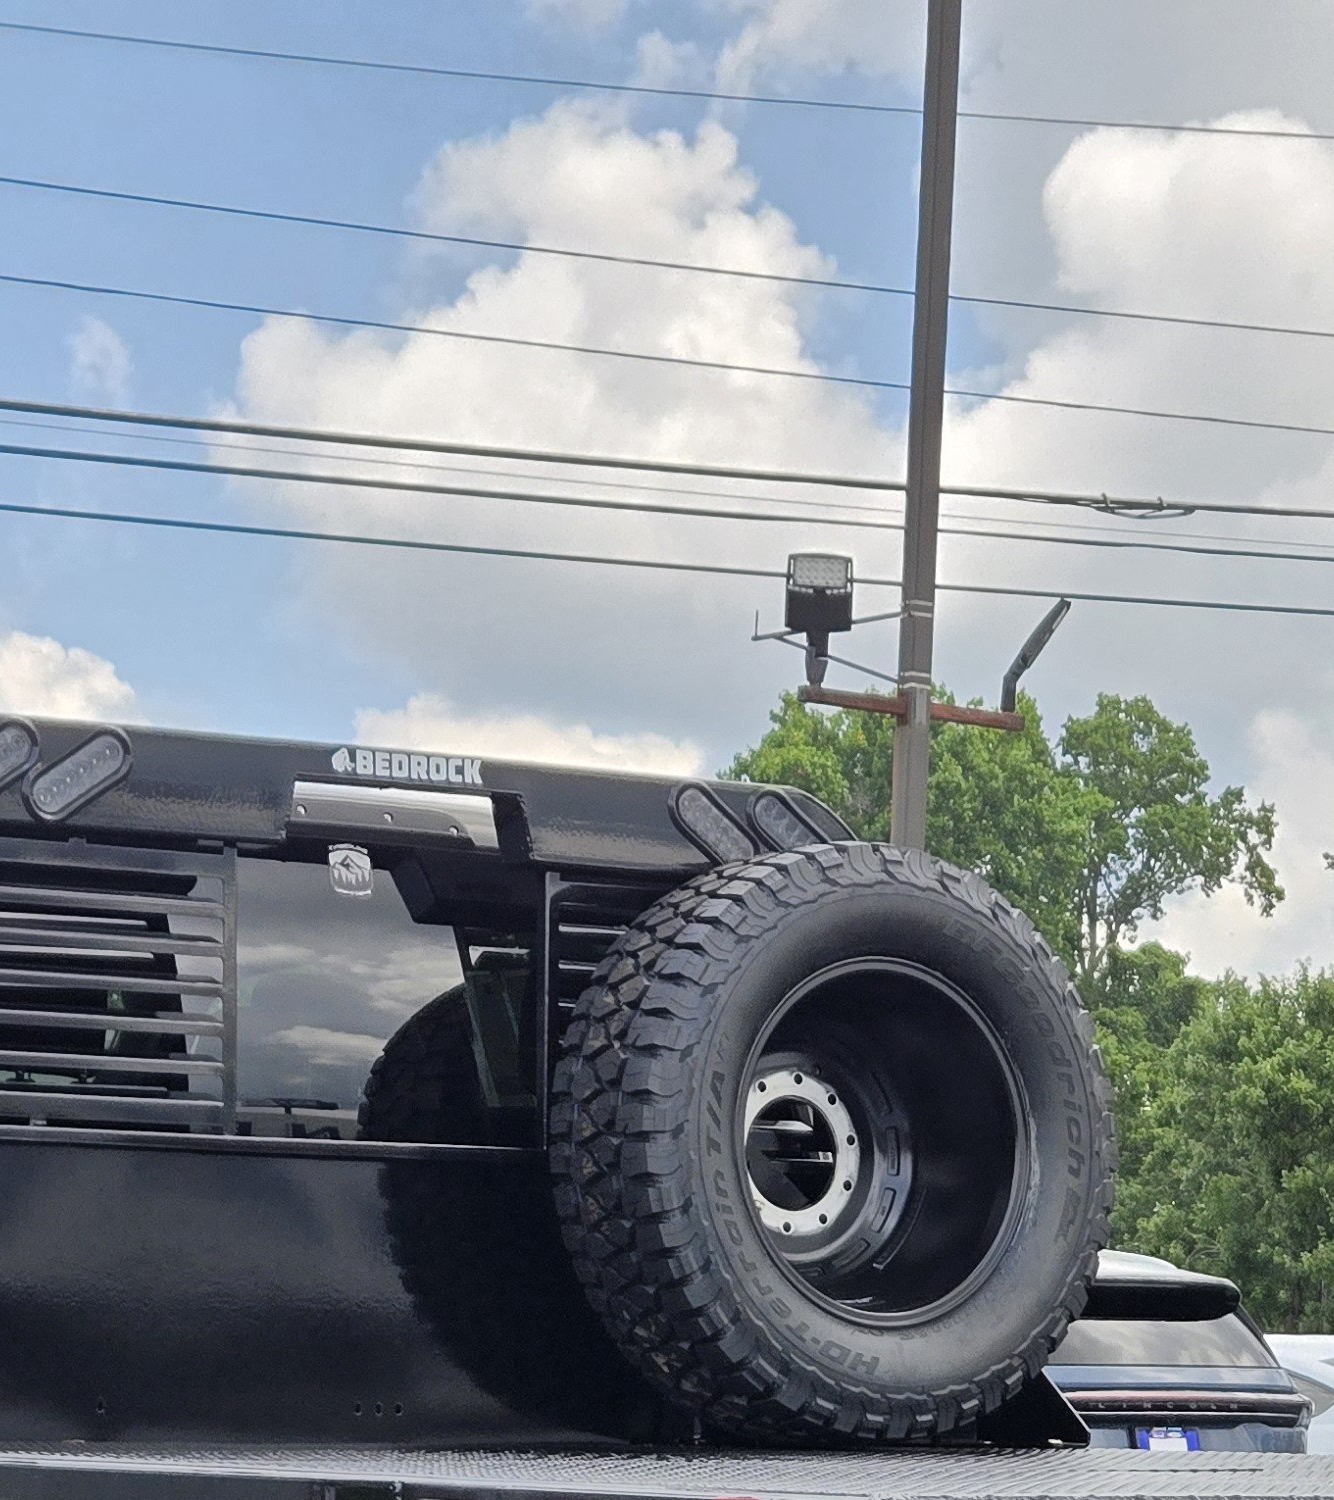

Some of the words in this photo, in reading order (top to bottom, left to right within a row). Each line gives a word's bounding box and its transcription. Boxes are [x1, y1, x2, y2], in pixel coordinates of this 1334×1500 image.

[355, 748, 483, 785] BEDROCK
[942, 917, 1087, 1180] BFGoodrich
[1097, 1402, 1238, 1410] LINCOLN
